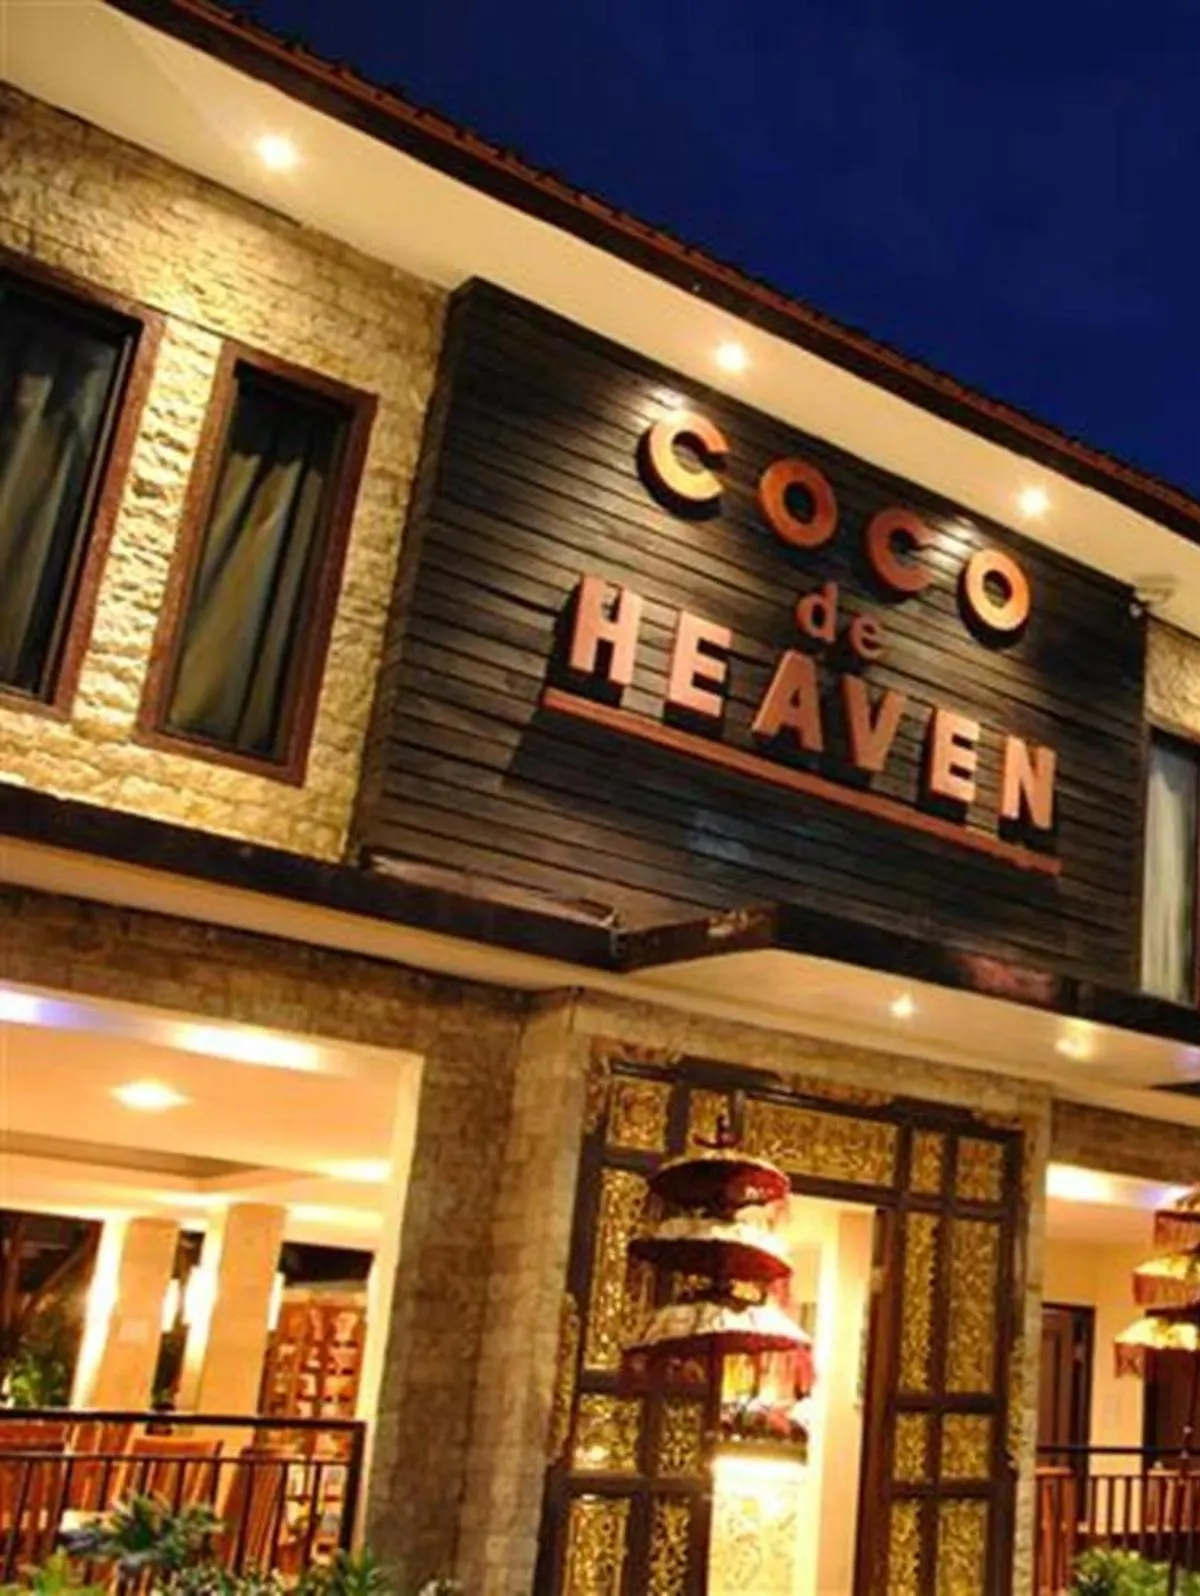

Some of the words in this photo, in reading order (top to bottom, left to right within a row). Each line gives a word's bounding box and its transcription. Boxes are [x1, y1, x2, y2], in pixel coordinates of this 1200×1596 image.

[646, 409, 1031, 633] COCO
[796, 582, 883, 660] de
[567, 574, 1057, 830] HEAVEN
